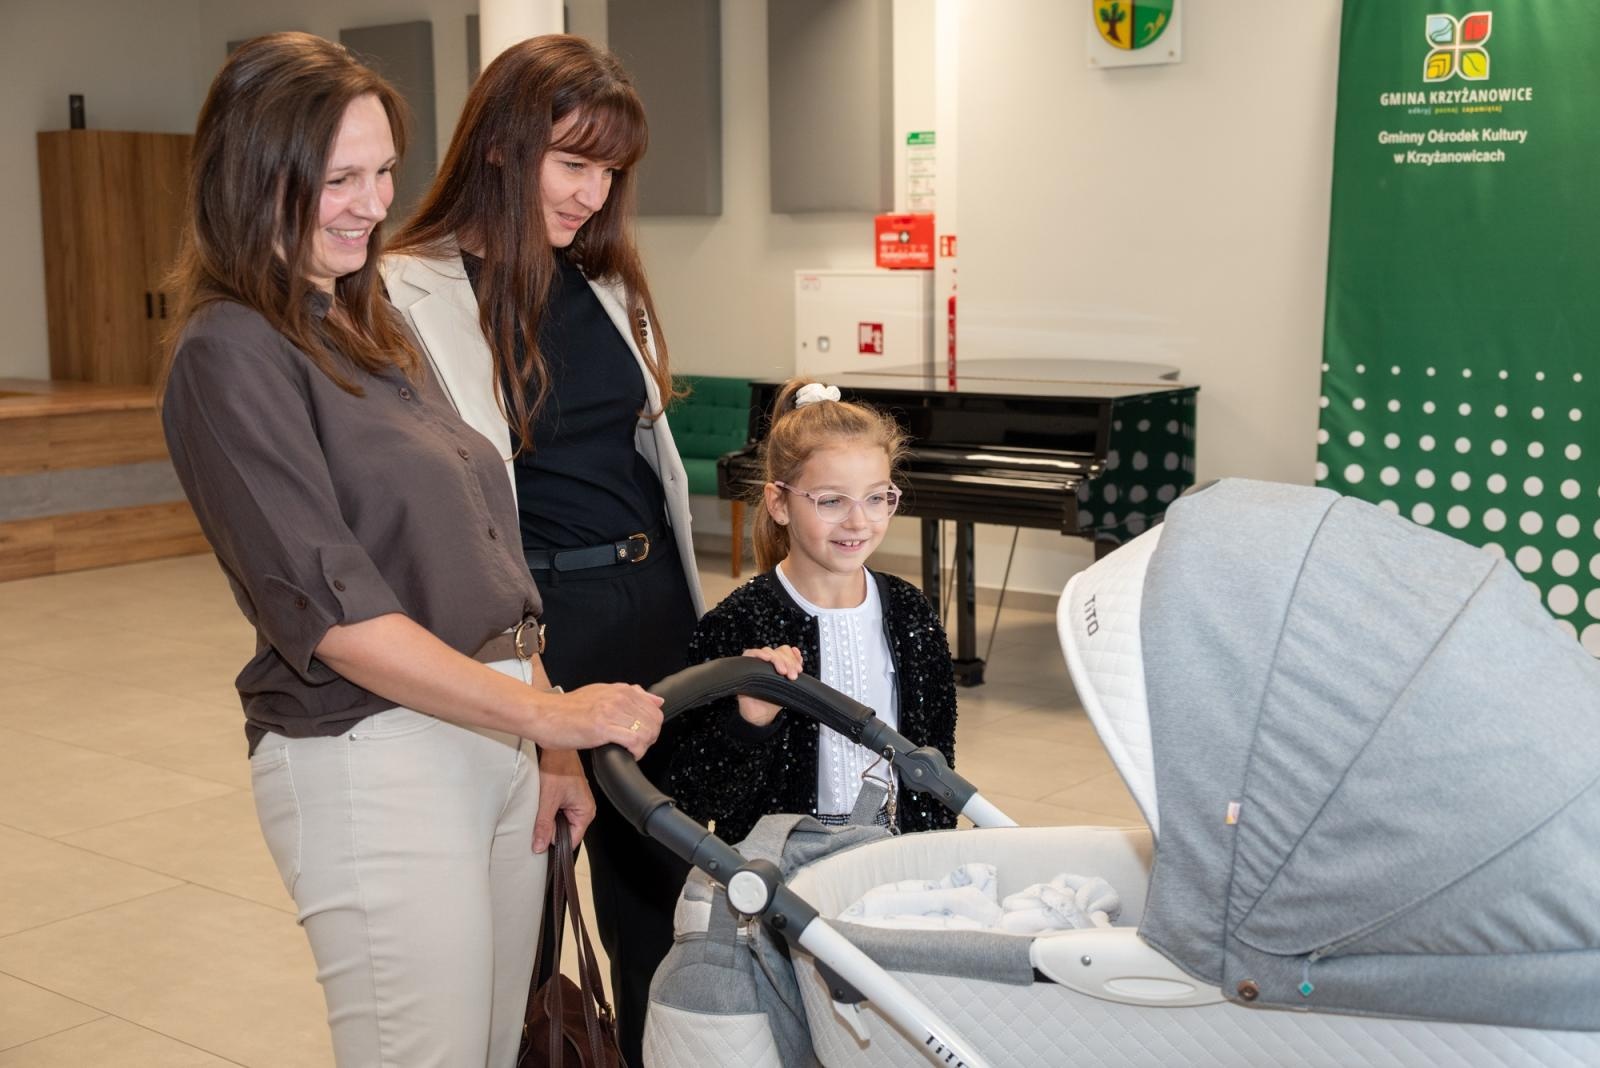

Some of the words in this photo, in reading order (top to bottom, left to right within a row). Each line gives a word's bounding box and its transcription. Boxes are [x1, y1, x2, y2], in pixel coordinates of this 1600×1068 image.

[1380, 92, 1426, 106] GMINA
[1430, 87, 1533, 104] KRZYŻANOWICE
[1378, 130, 1425, 146] Gminny
[1427, 129, 1479, 143] Ośrodek
[1482, 128, 1528, 143] Kultury
[1393, 153, 1405, 164] w
[1407, 149, 1505, 166] Krzyżanowicach
